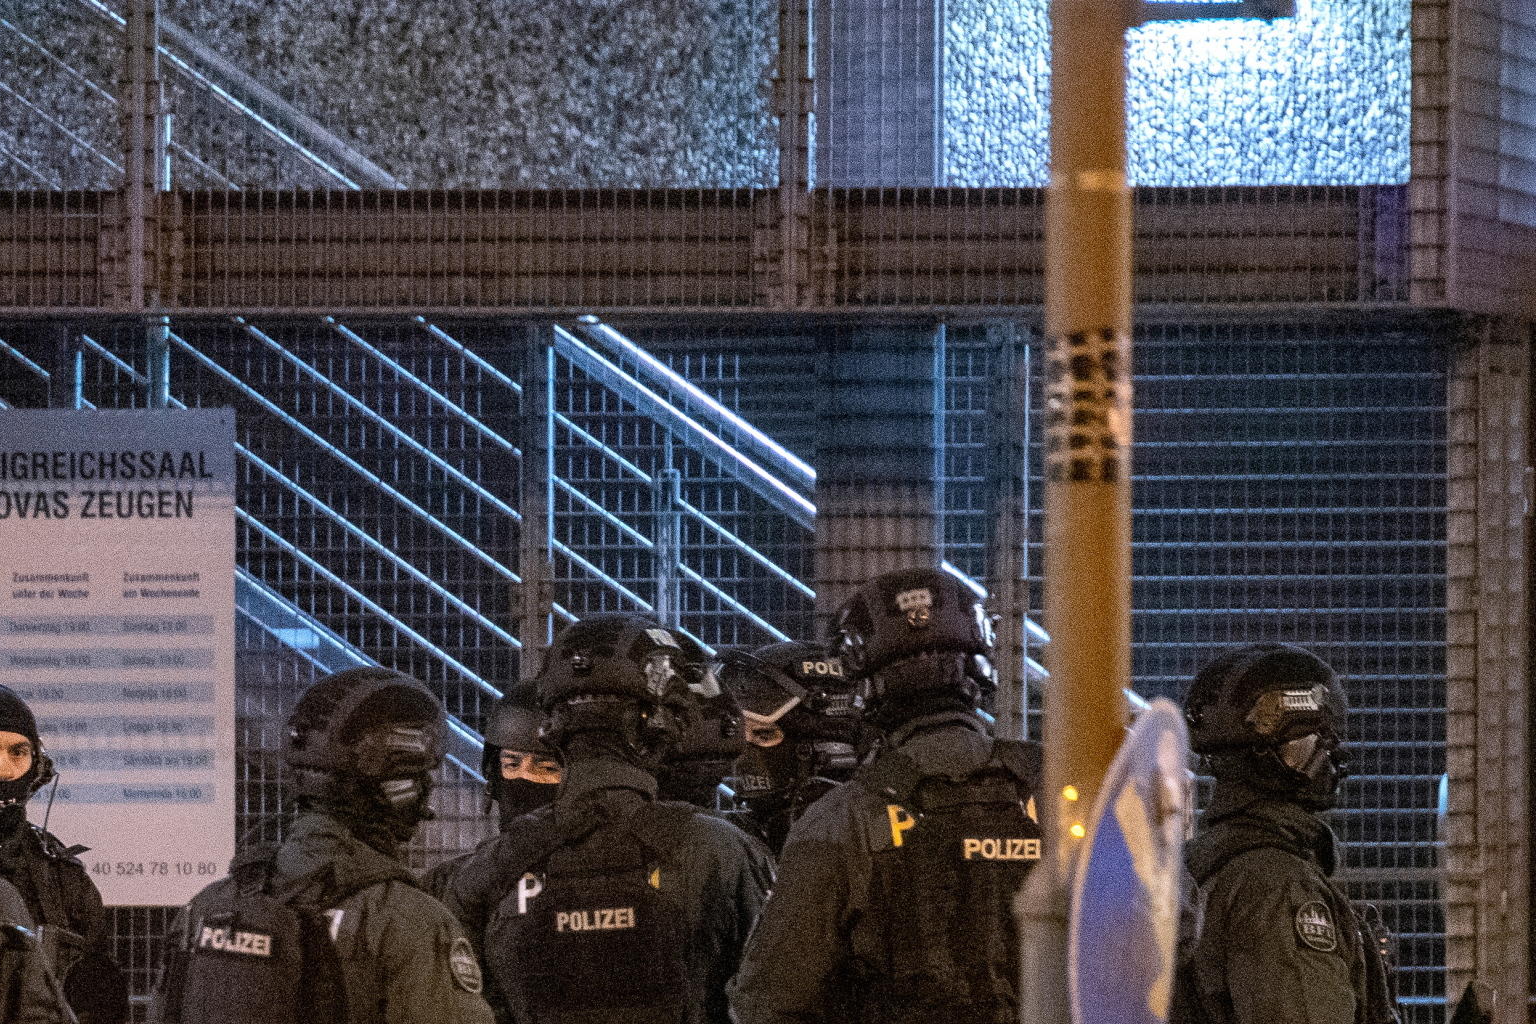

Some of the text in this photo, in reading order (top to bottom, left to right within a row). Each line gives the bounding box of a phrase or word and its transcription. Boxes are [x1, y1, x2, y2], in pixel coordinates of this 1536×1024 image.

[80, 490, 195, 519] ZEUGEN
[802, 661, 843, 677] POLI
[886, 804, 915, 848] P
[964, 838, 1041, 860] POLIZEI
[92, 861, 218, 876] 40 524 78 10 80
[517, 872, 543, 914] P
[557, 907, 636, 933] POLIZEI
[199, 926, 272, 957] POLIZEI
